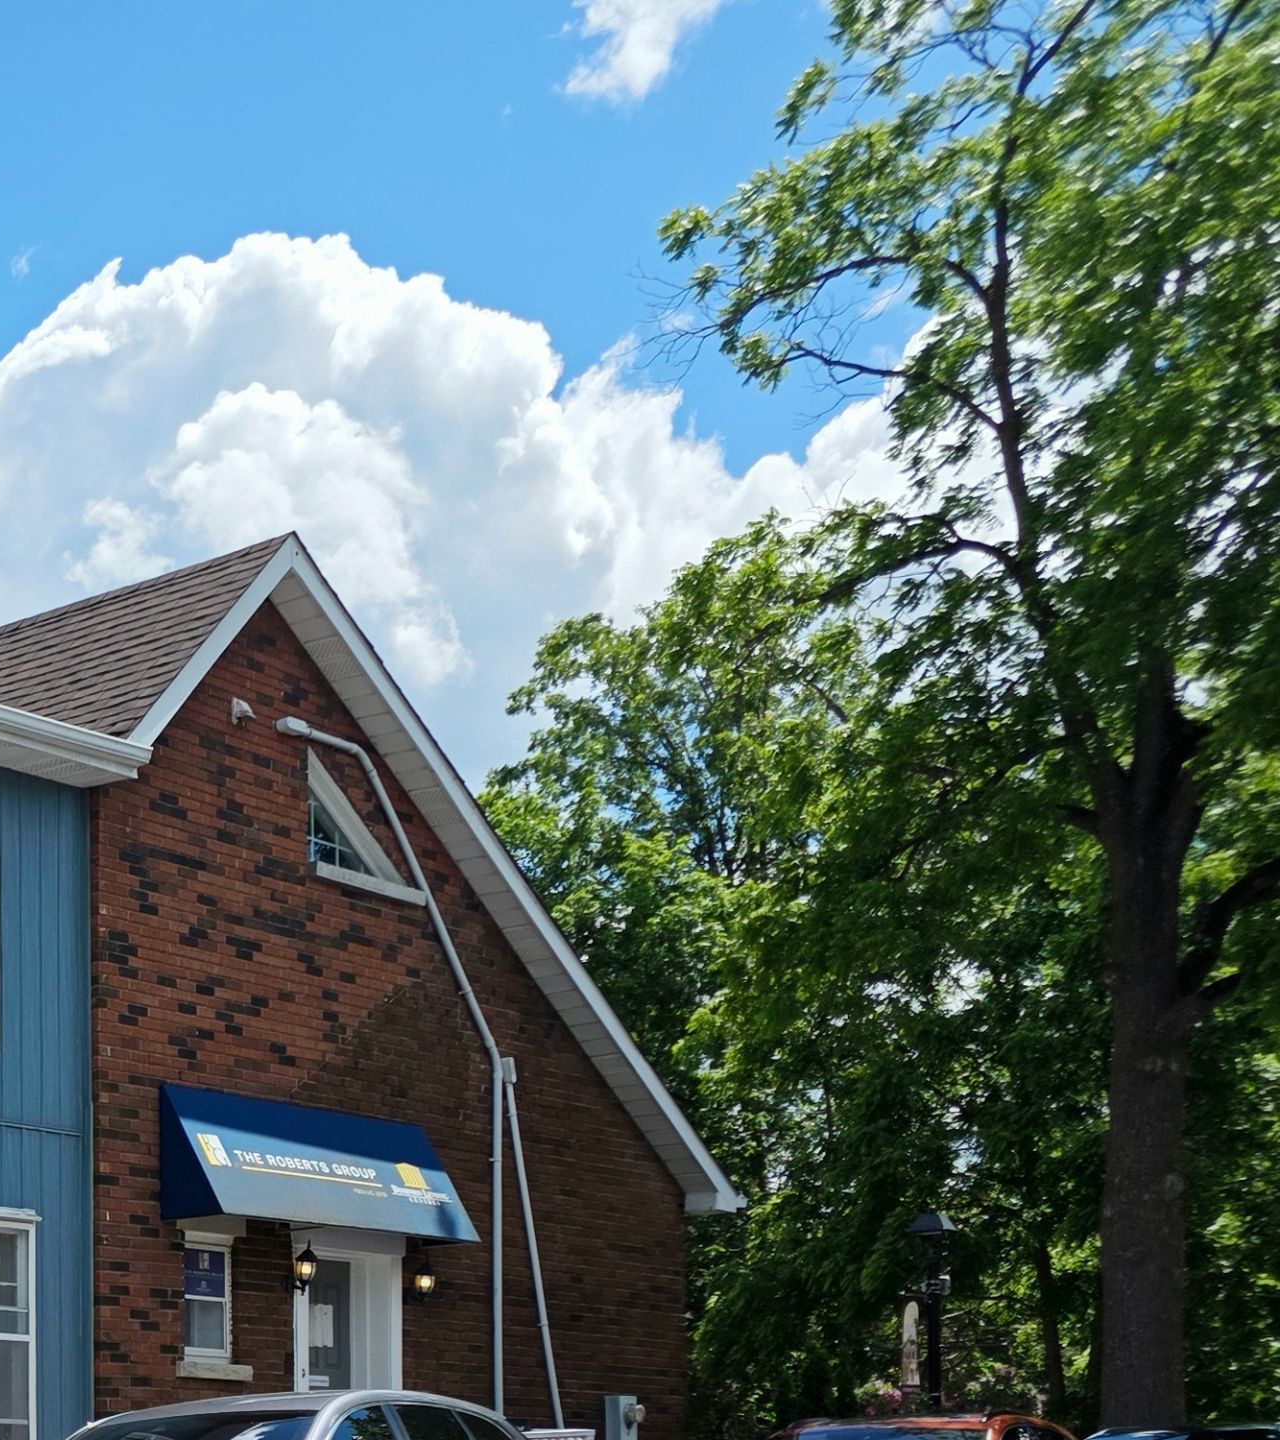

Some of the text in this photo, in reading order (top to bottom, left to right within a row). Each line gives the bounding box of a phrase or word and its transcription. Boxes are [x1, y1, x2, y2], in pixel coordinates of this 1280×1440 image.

[233, 1150, 377, 1180] THE ROBERTS GROUP
